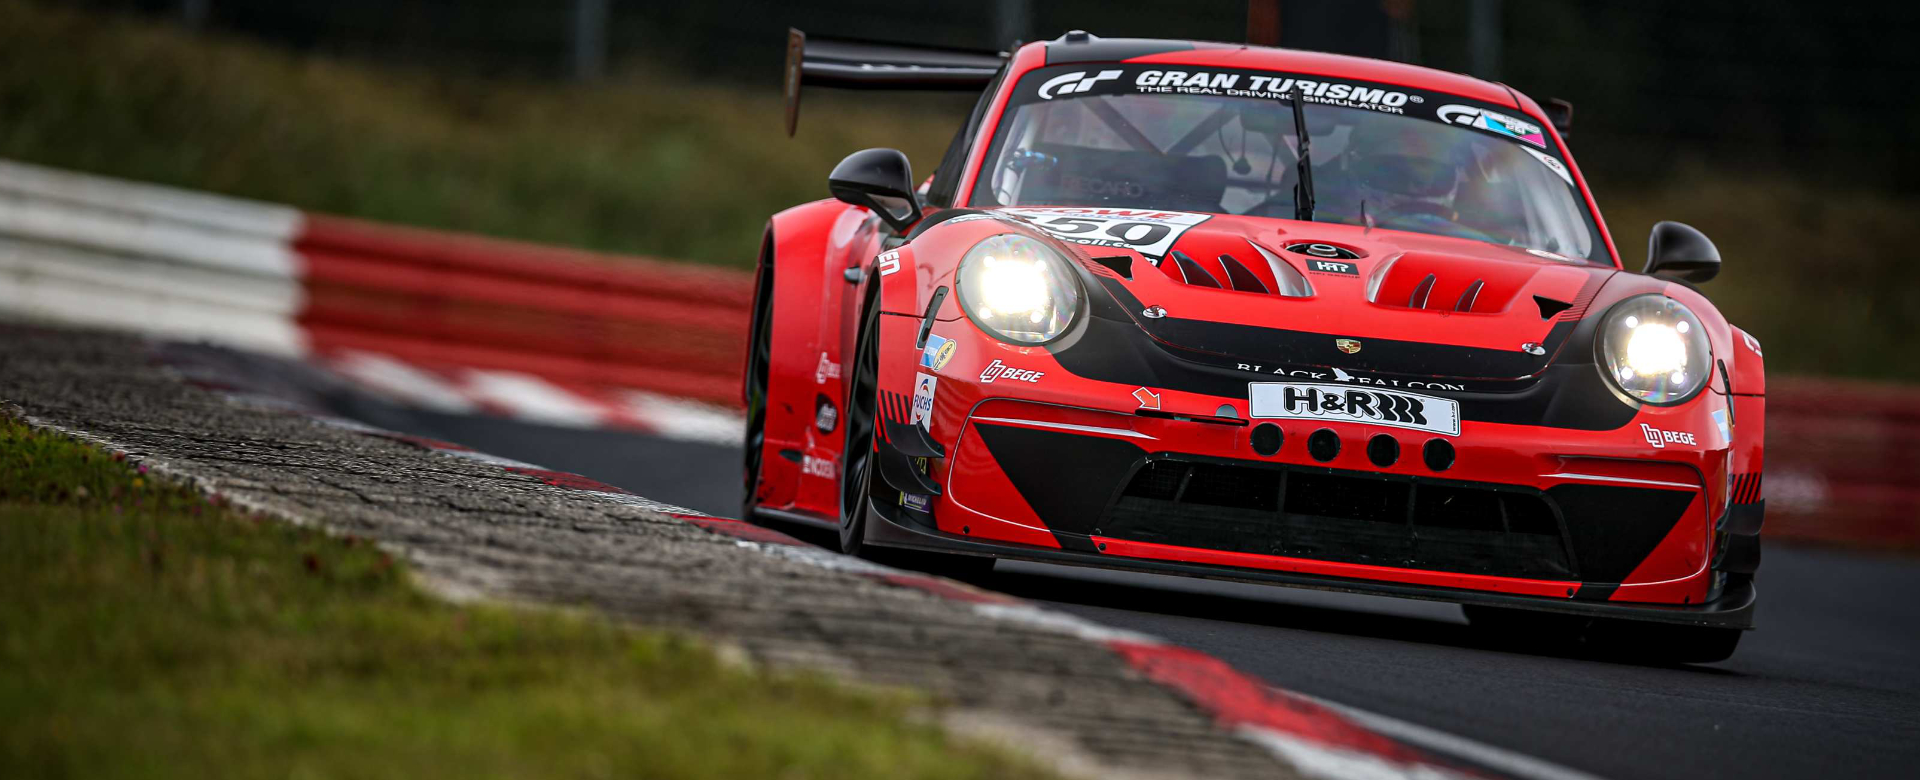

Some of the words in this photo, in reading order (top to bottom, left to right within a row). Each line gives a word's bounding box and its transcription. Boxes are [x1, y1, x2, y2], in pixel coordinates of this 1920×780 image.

[1136, 70, 1239, 88] GRAN
[1177, 86, 1223, 95] REAL
[1303, 95, 1404, 115] SIMULATOR
[1001, 367, 1045, 383] BEGE
[914, 394, 932, 411] FUCHS
[1284, 387, 1397, 420] H&R
[1663, 430, 1697, 446] BEGE
